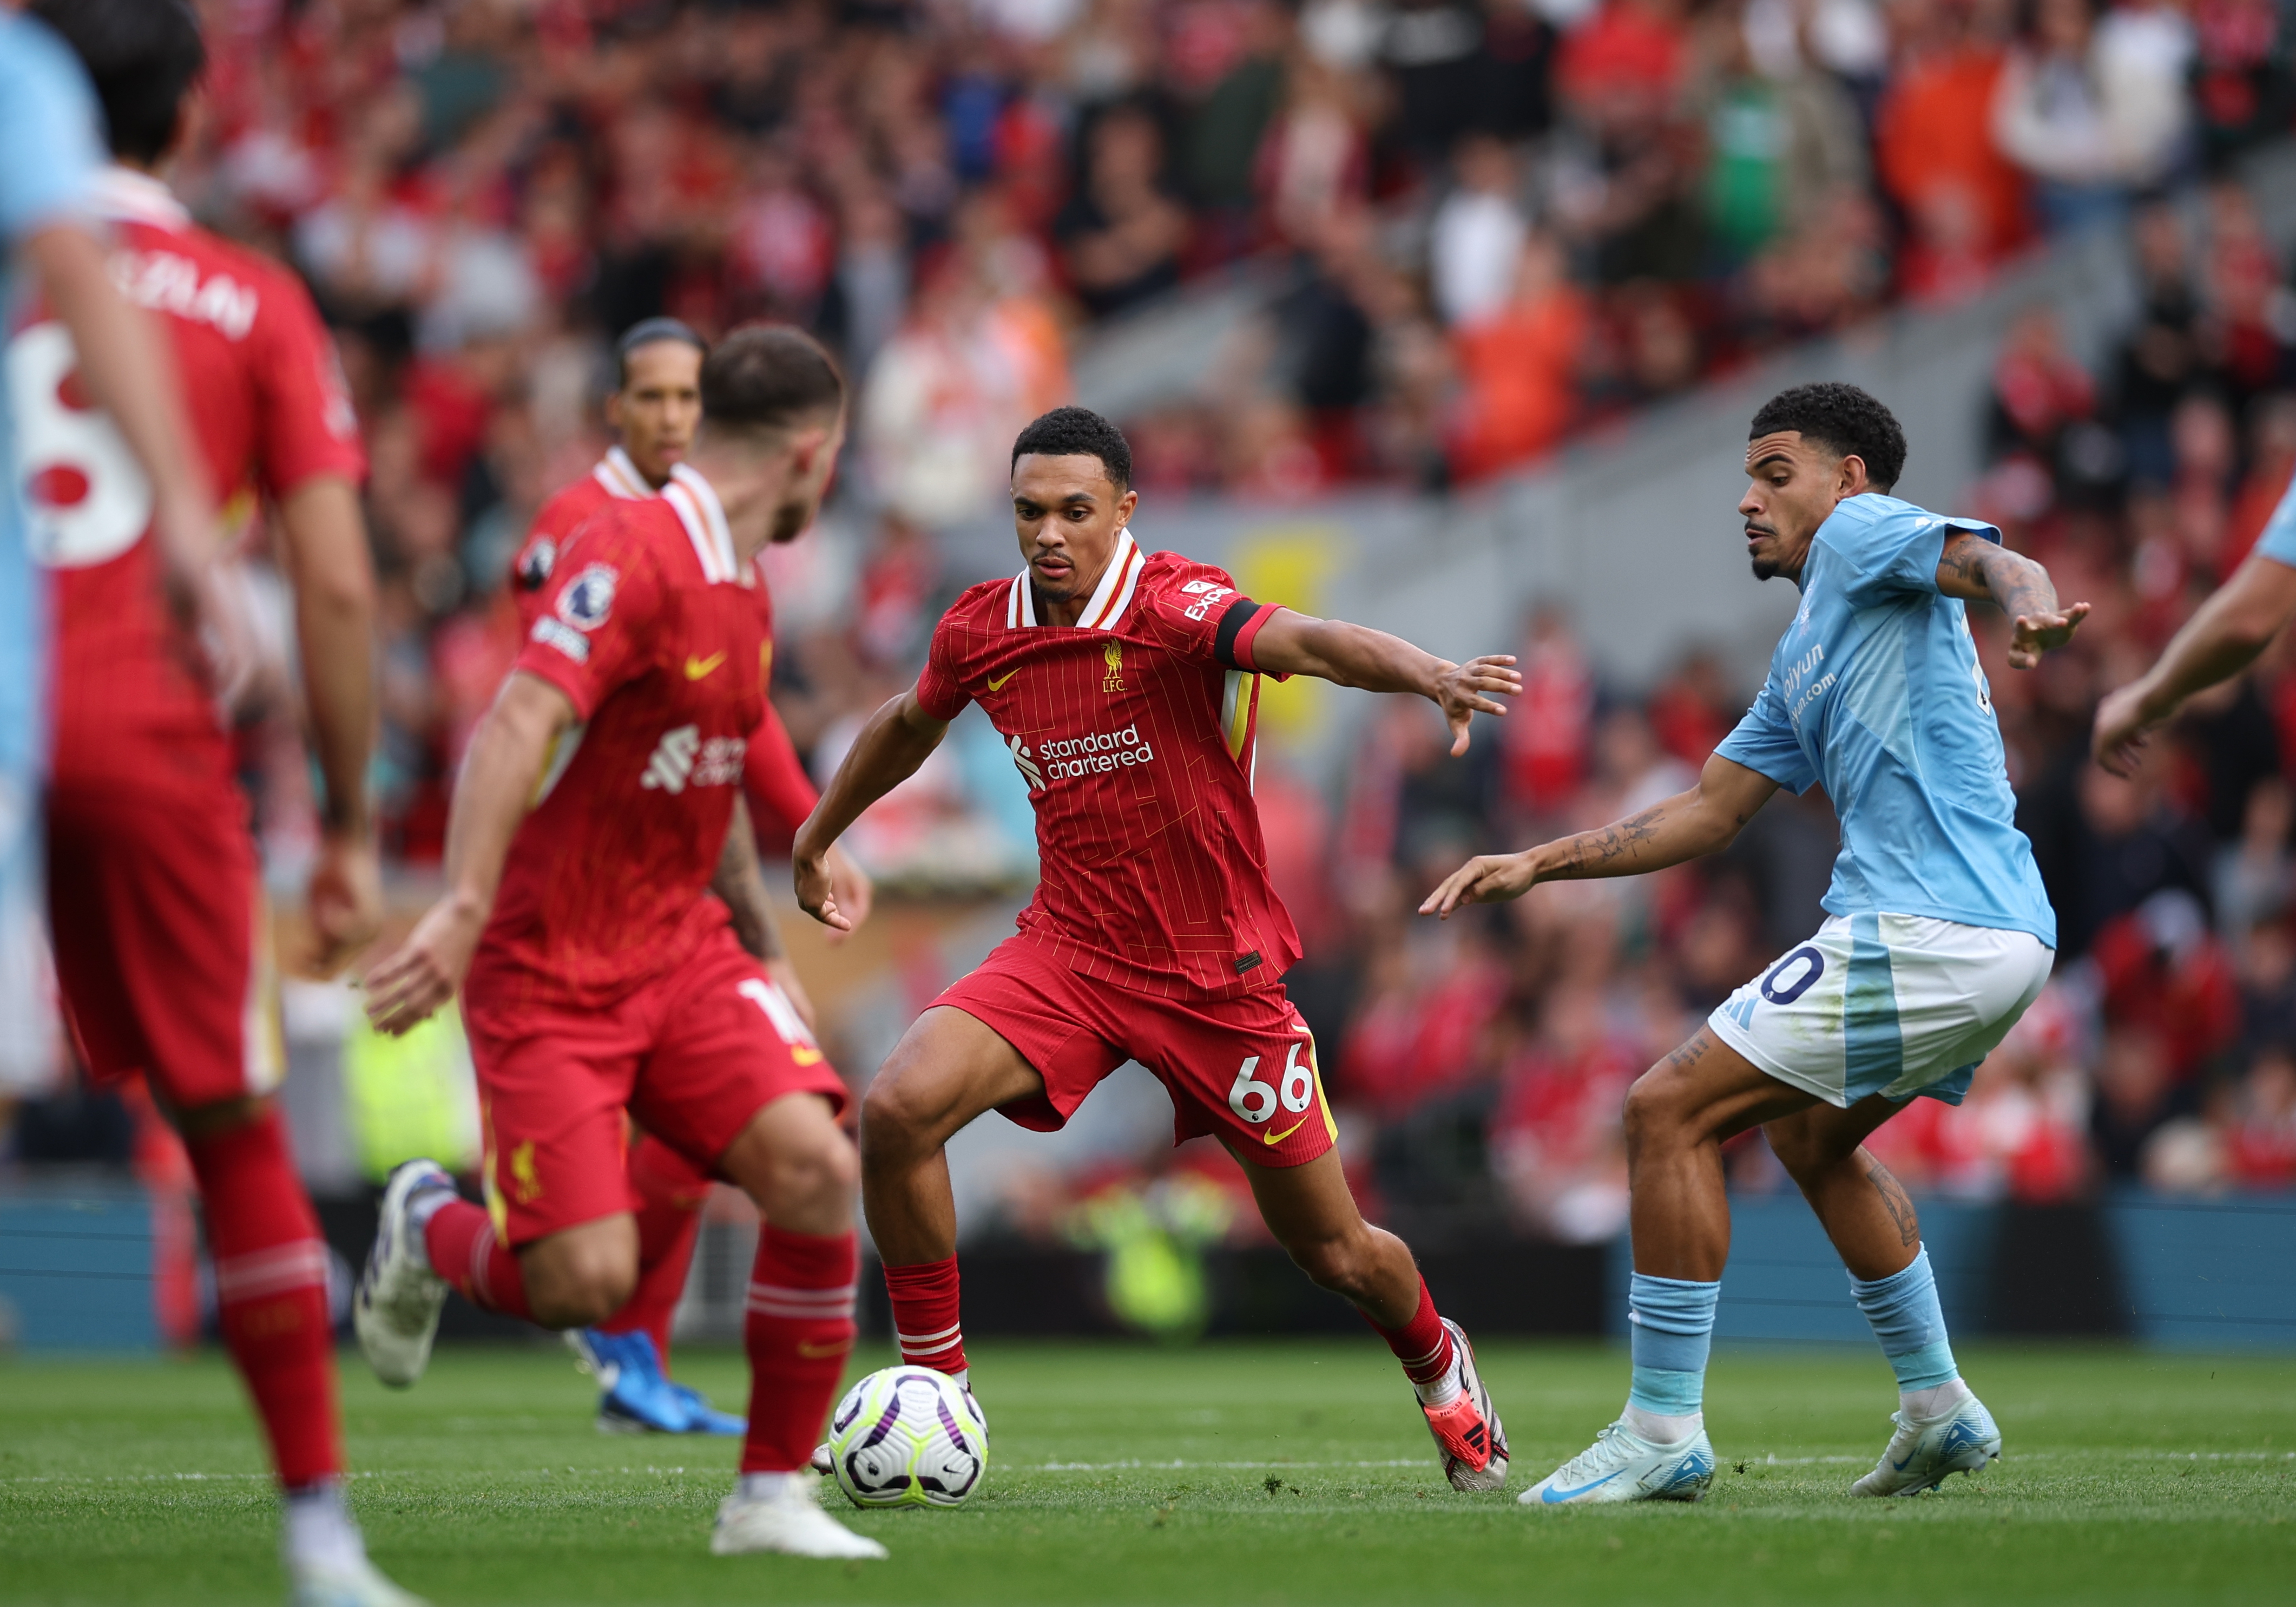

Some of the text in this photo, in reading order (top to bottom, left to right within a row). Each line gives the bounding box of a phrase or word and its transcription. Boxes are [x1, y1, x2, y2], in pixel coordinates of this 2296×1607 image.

[1102, 679, 1128, 693] L.F.C.
[1784, 643, 1824, 704] aiyun
[1040, 723, 1139, 760] standard
[1048, 742, 1154, 779] chartered
[1229, 1042, 1313, 1123] 66
